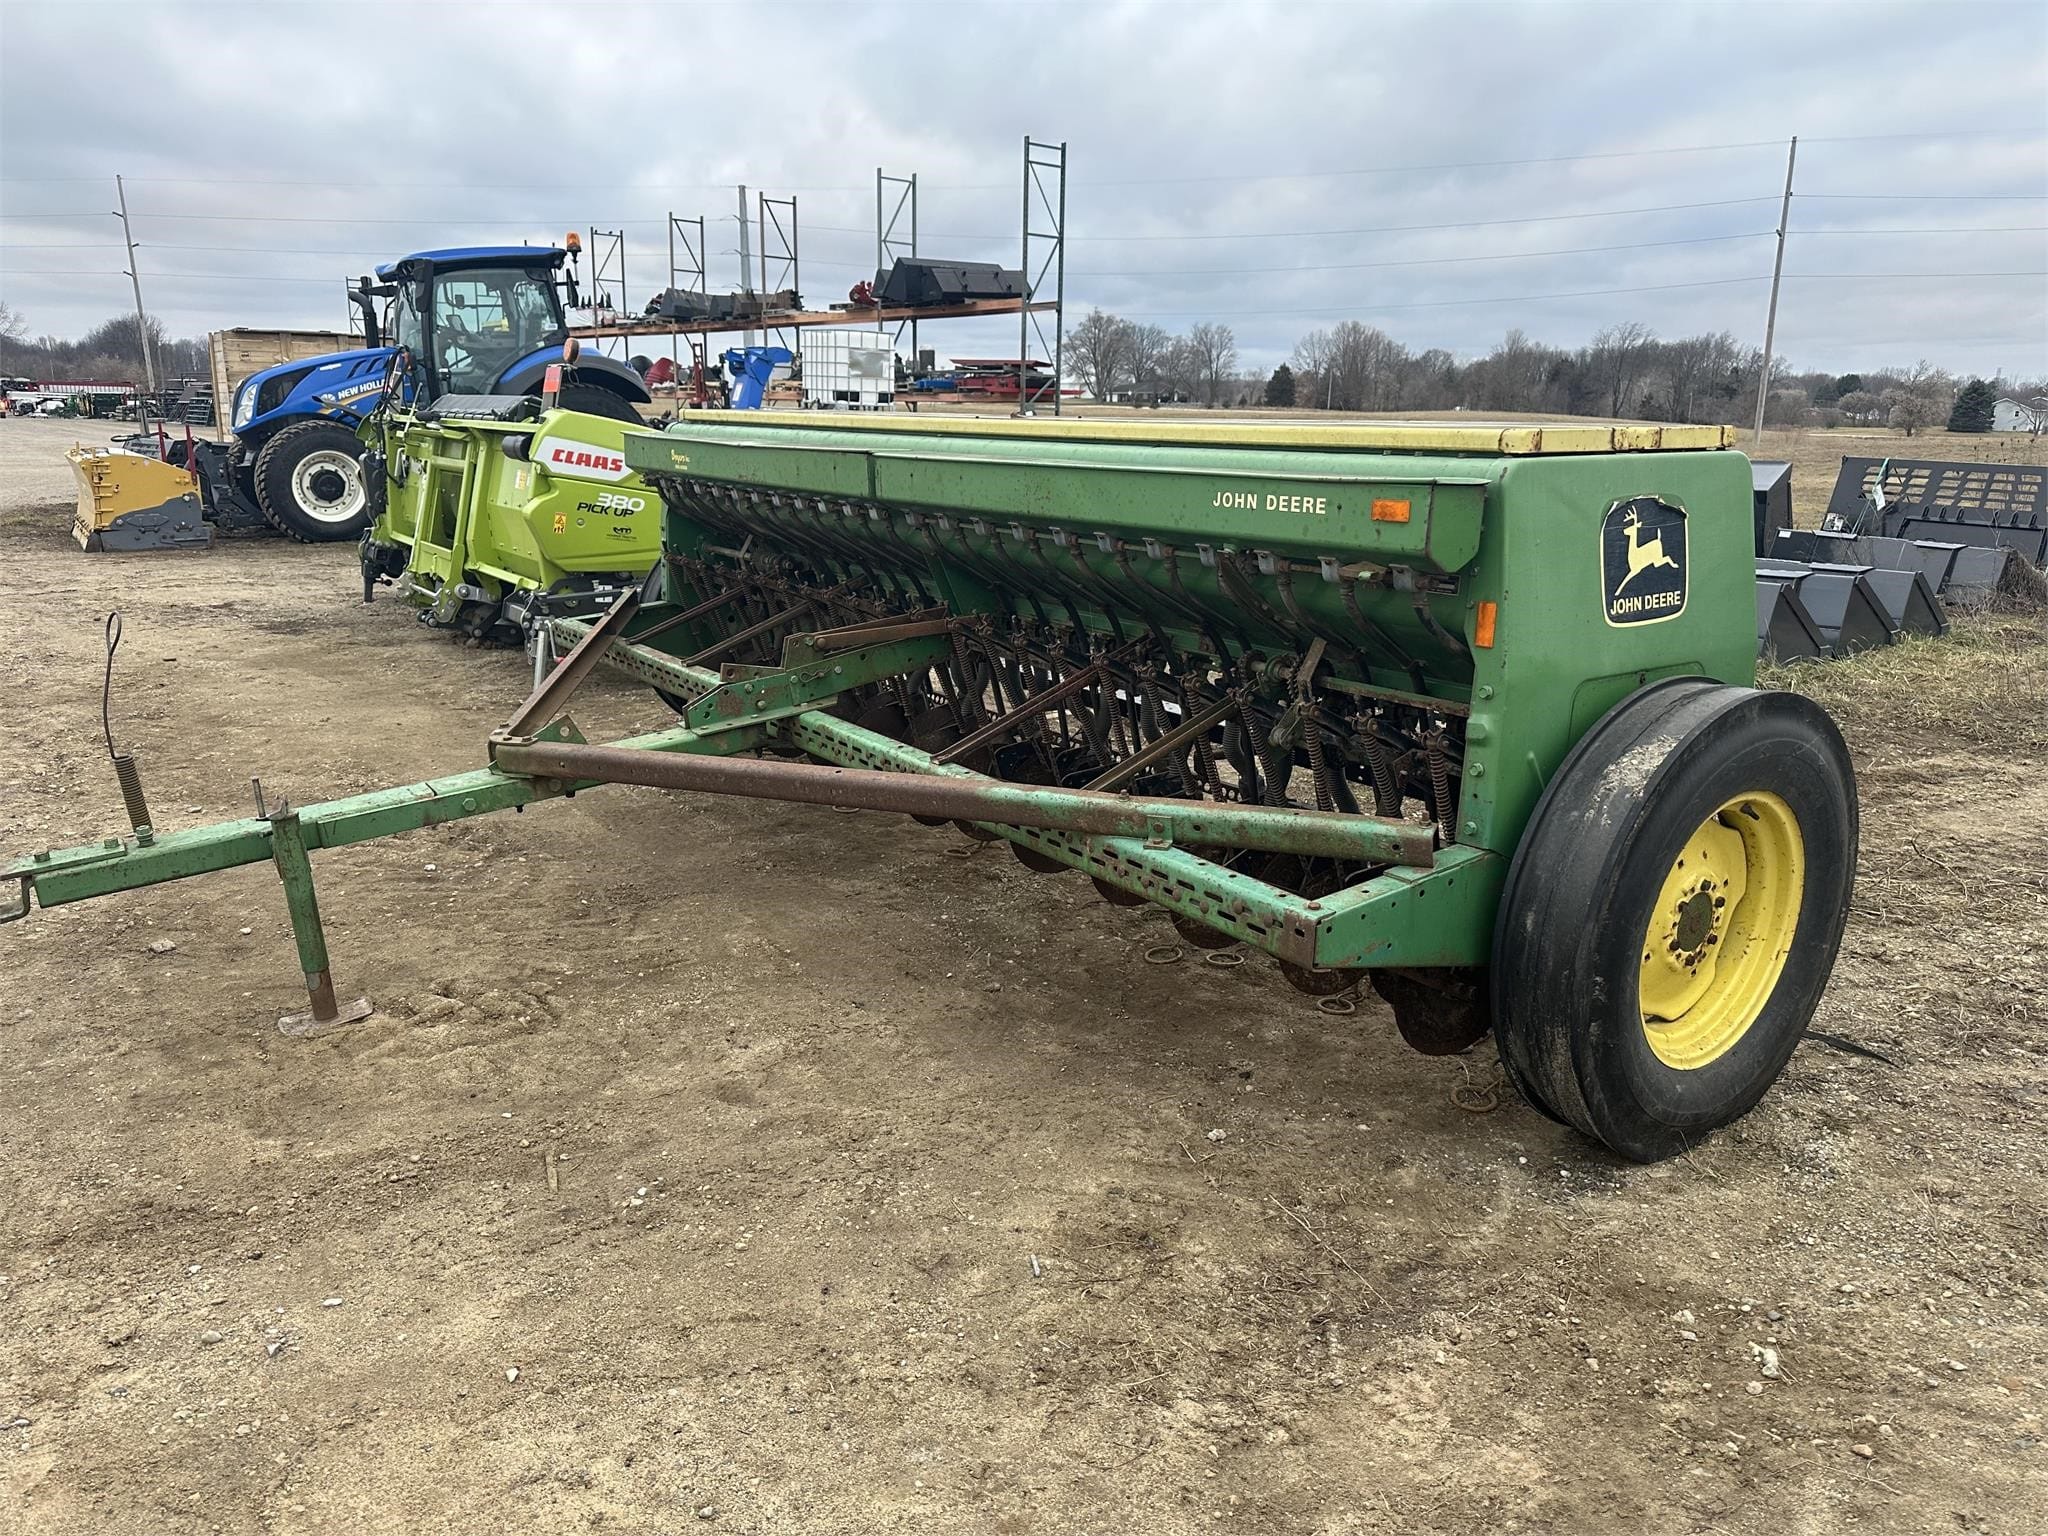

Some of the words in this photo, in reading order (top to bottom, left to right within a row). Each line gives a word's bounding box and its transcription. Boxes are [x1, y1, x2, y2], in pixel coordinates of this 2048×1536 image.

[338, 386, 359, 400] NEW
[551, 448, 624, 473] CLAAS
[577, 502, 611, 516] PICK
[613, 507, 635, 518] UP
[596, 492, 645, 512] 380
[1212, 491, 1258, 510] JOHN
[1266, 494, 1327, 515] DEERE
[1610, 595, 1643, 615] JOHN
[1644, 590, 1681, 610] DEERE
